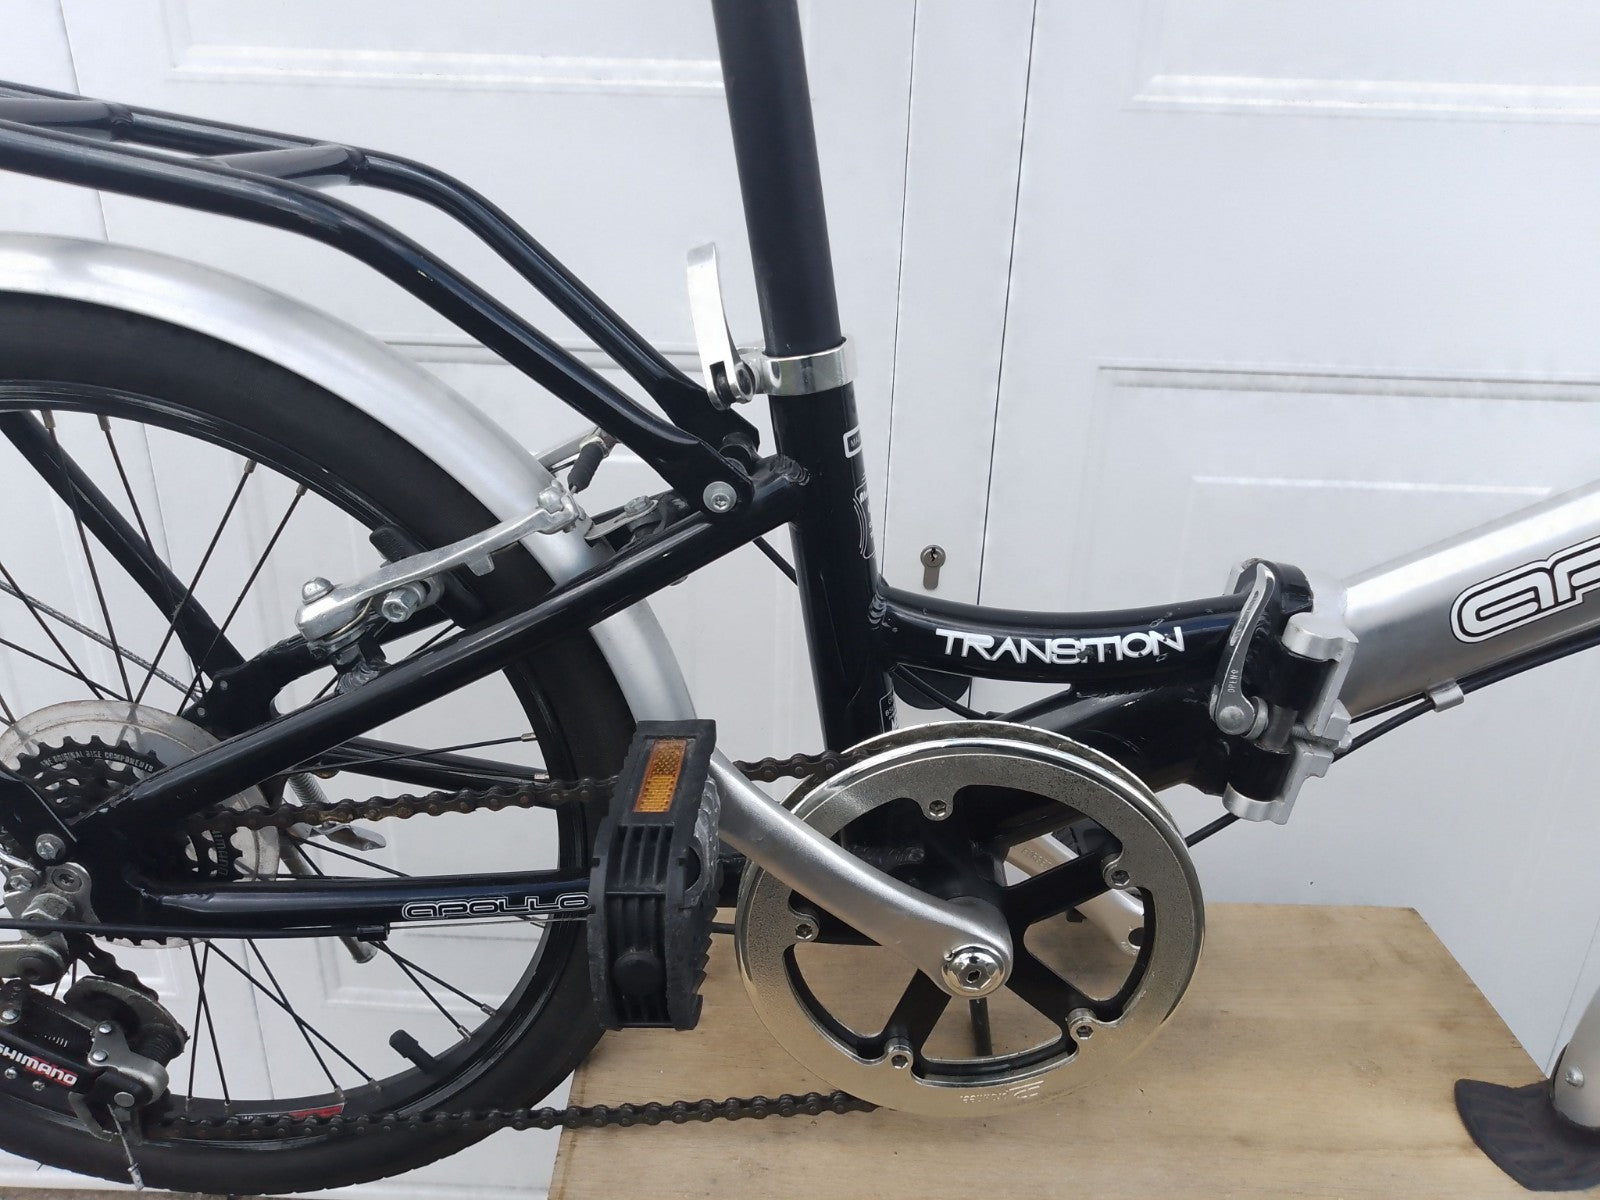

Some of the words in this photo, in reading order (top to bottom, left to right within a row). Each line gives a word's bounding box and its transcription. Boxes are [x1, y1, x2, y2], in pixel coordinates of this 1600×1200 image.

[935, 626, 1185, 664] TRANSITION
[53, 751, 84, 762] ORIGINAL
[104, 751, 154, 772] COMPONENTS
[402, 892, 591, 920] APOLLO
